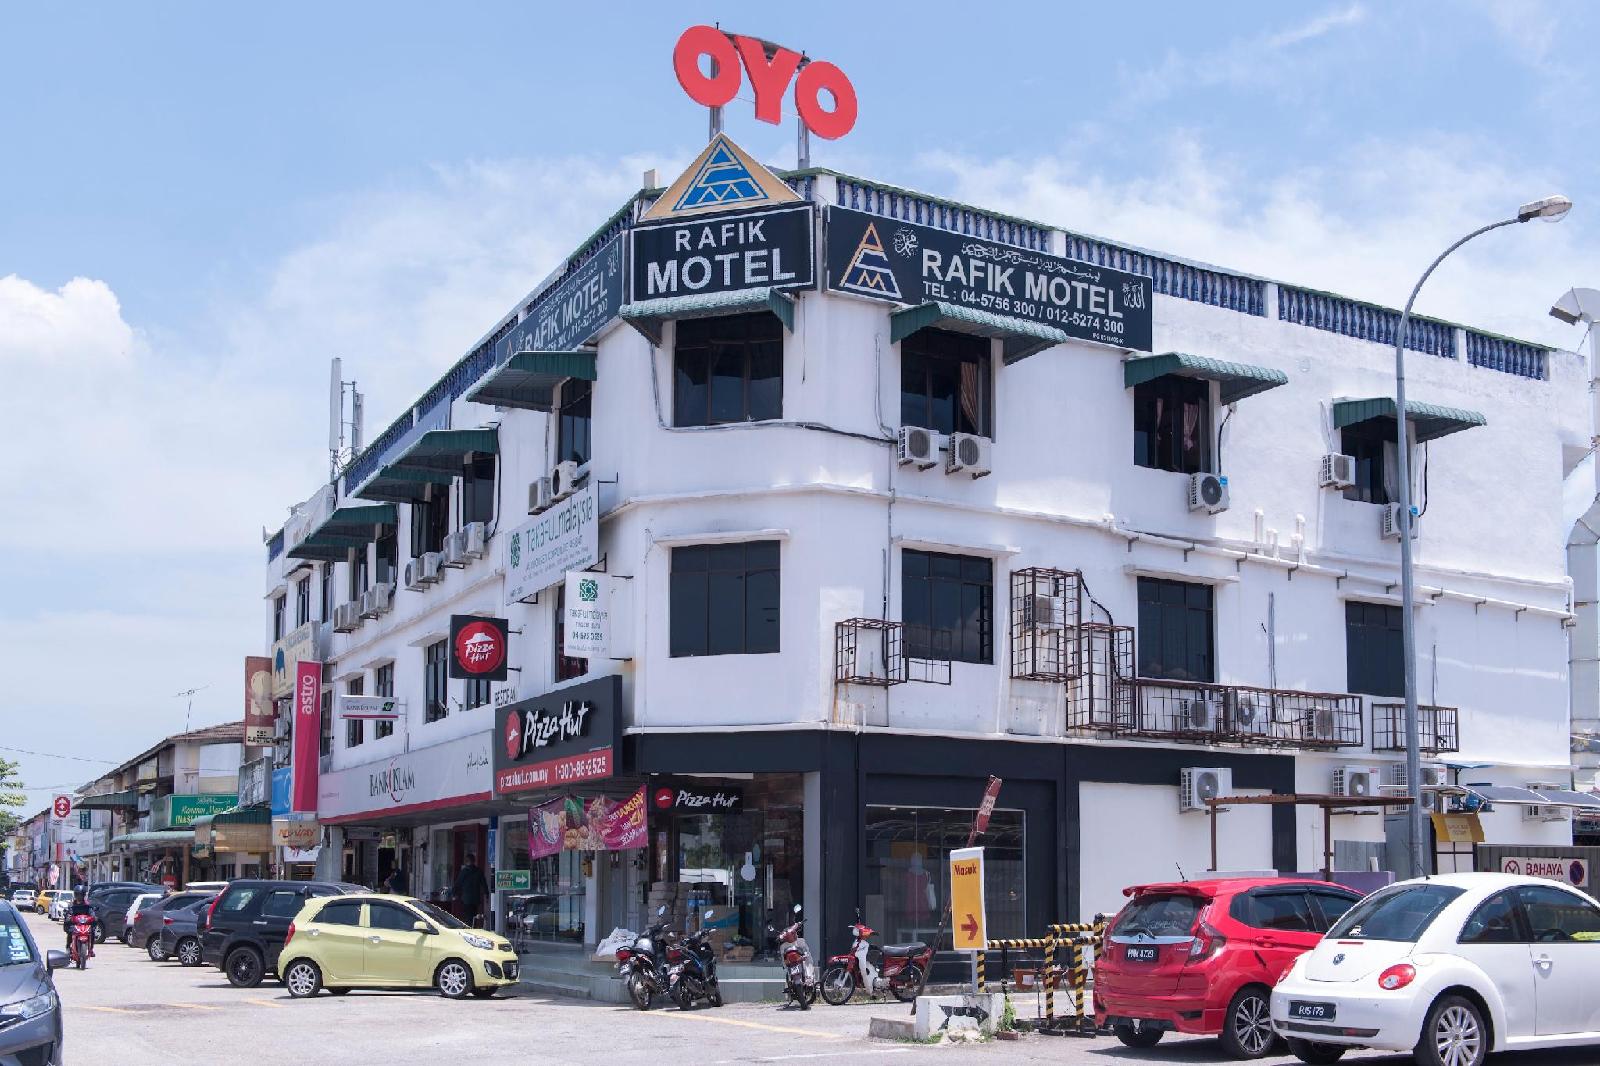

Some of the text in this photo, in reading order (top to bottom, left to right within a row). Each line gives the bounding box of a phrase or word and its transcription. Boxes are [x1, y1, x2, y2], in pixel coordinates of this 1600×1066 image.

[673, 24, 858, 141] OYO
[675, 219, 767, 252] RAFIK
[647, 248, 796, 295] MOTEL
[922, 248, 1124, 318] RAFIK MOTEL
[562, 271, 608, 328] MOTEL
[922, 280, 949, 298] TEL
[960, 289, 1010, 311] 04-5756
[1013, 300, 1036, 317] 300
[1046, 306, 1101, 330] 012-5274
[1103, 318, 1124, 334] 300
[470, 651, 492, 664] Hut
[301, 675, 315, 715] astro
[523, 700, 590, 753] Pizza Hut
[675, 790, 739, 807] Pizza Hut
[953, 863, 977, 876] Masuk
[1525, 862, 1564, 876] BAHAYA
